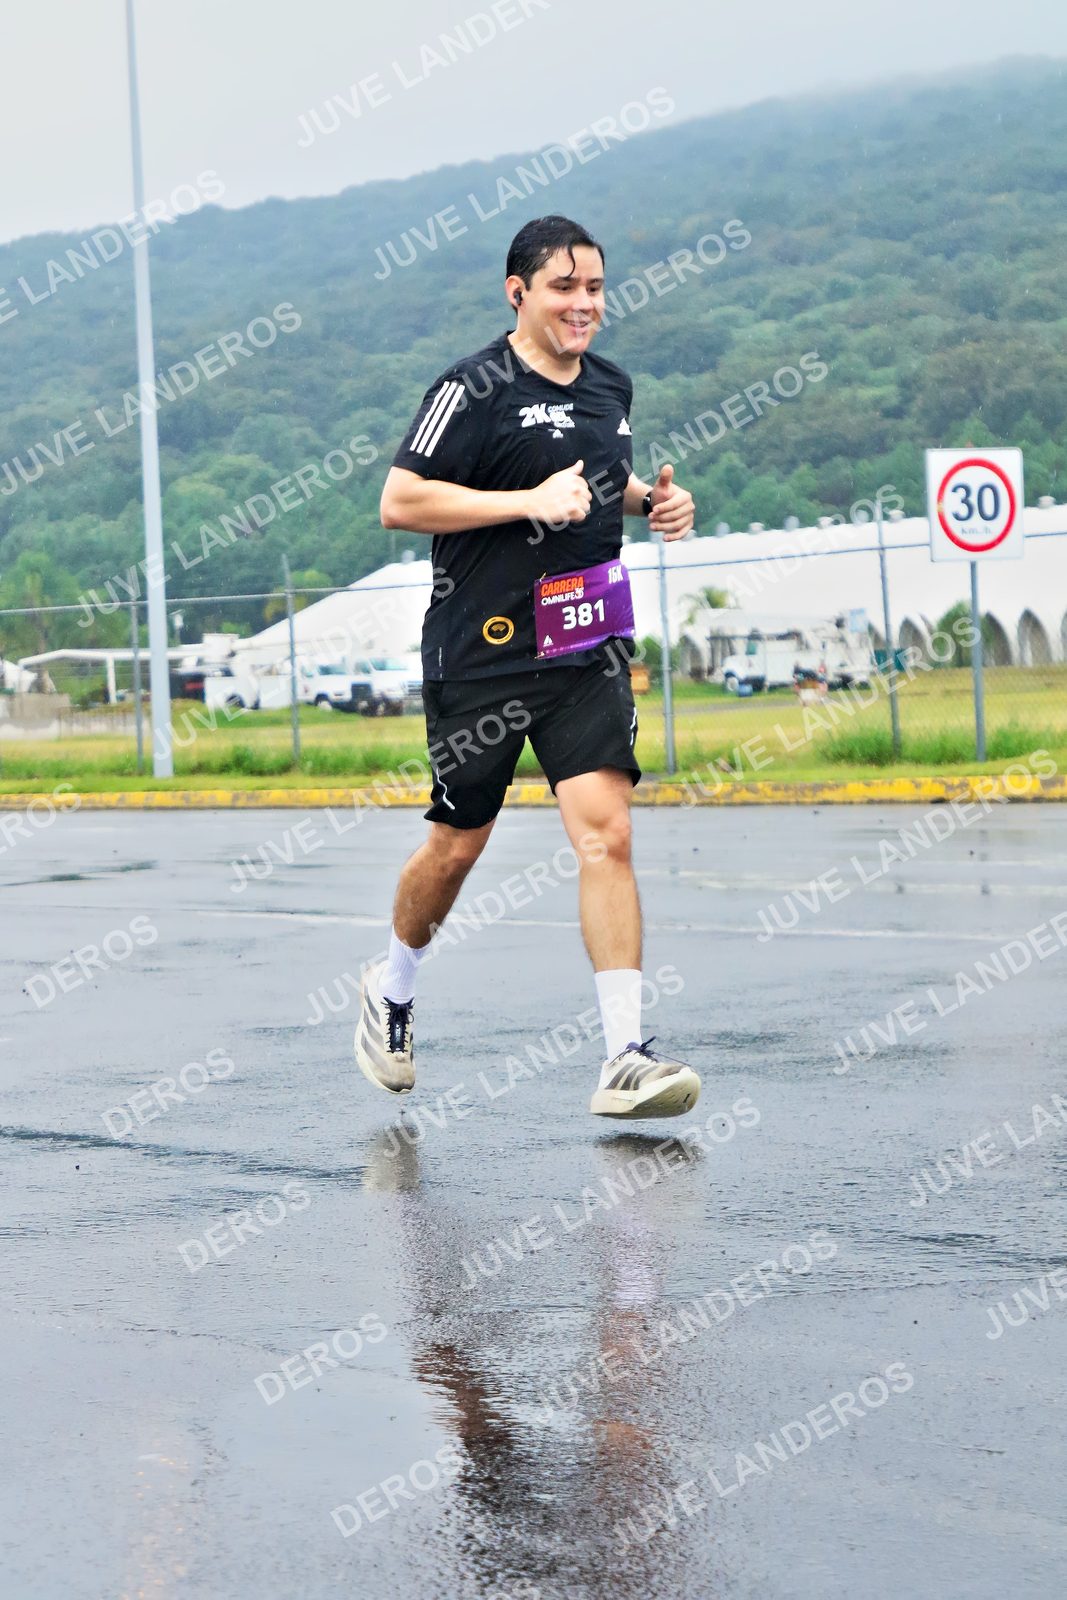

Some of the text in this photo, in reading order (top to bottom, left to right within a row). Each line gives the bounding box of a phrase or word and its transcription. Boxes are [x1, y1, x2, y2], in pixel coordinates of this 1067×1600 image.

[952, 483, 1000, 521] 30
[541, 576, 584, 597] CARRERA
[562, 599, 605, 630] 381
